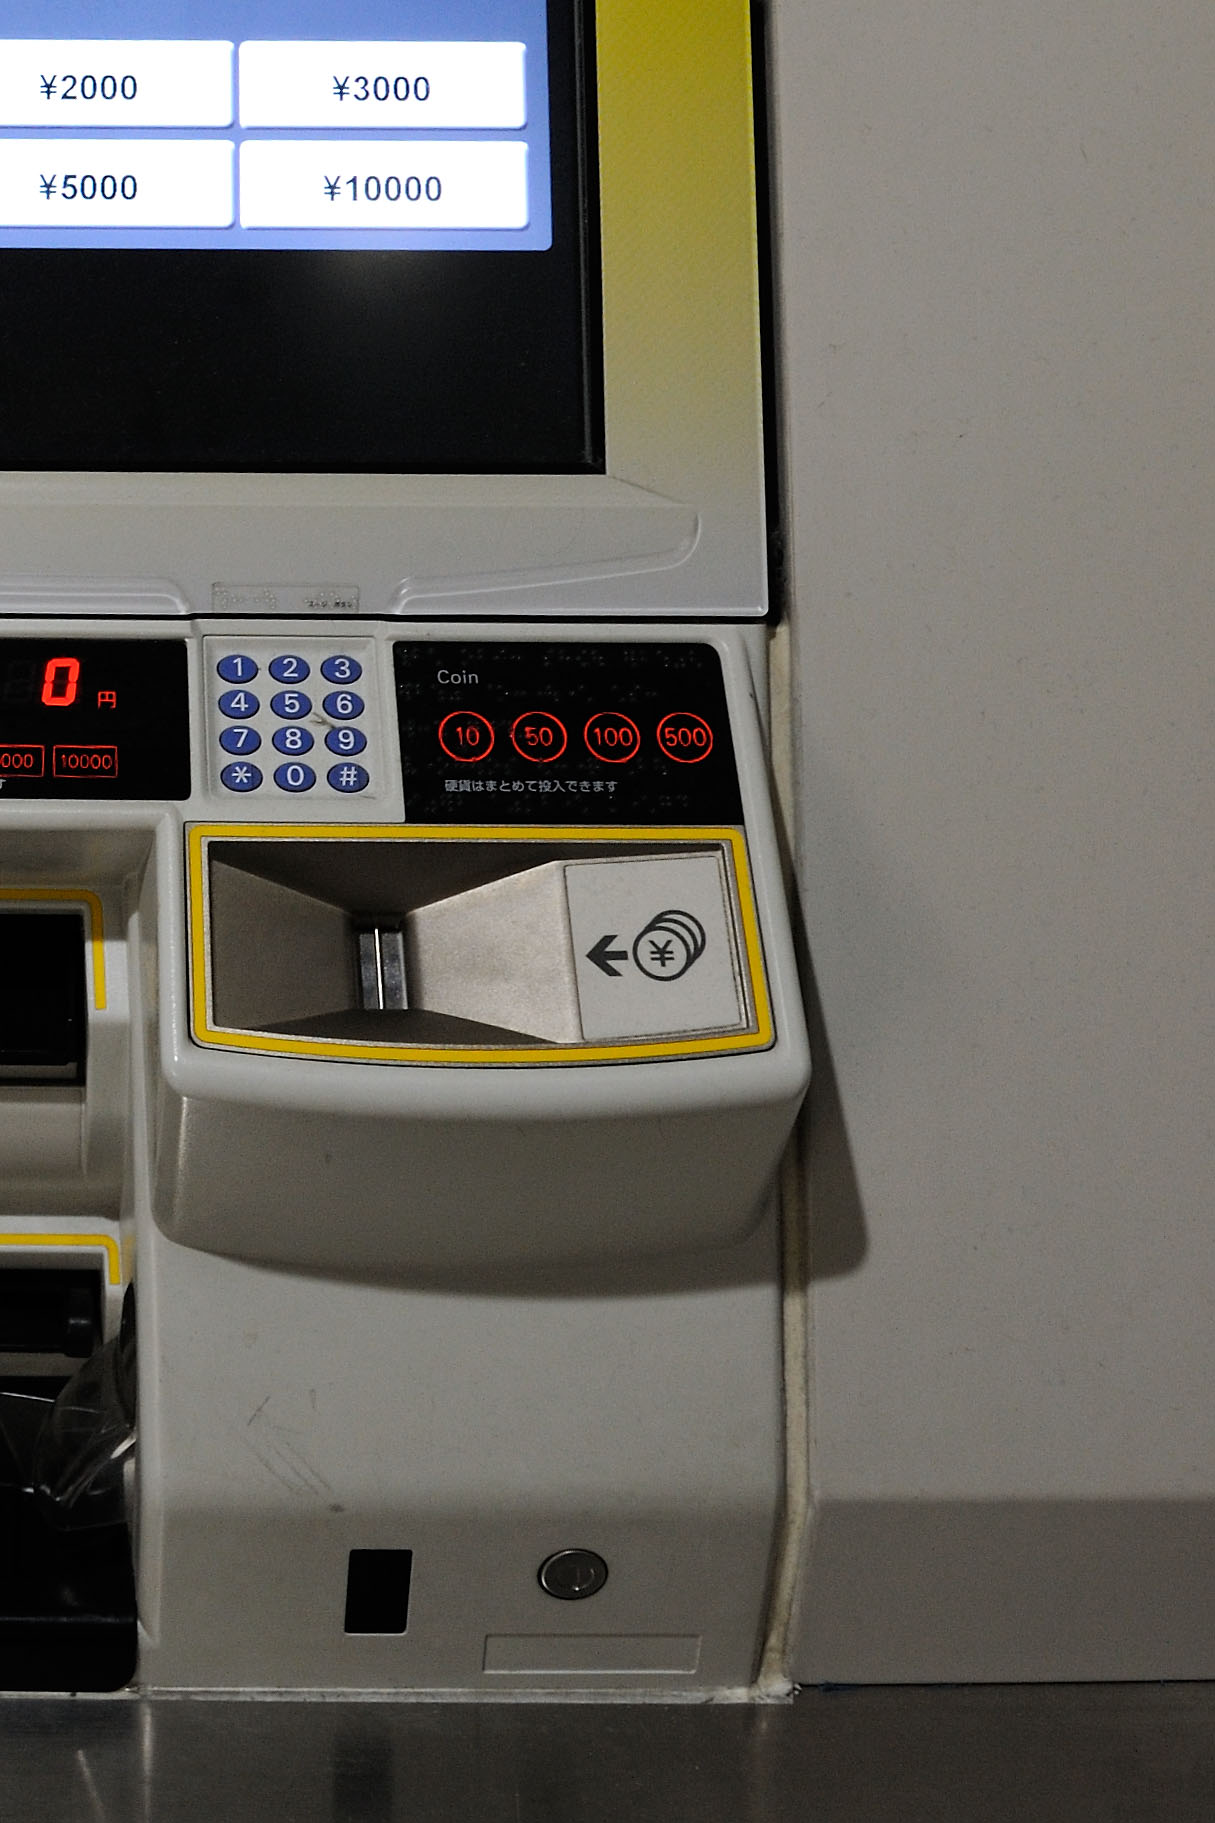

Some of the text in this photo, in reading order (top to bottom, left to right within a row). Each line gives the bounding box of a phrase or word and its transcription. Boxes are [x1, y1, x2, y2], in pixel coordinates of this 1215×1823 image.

[40, 75, 137, 99] ¥2000
[333, 76, 429, 101] ¥3000
[40, 175, 137, 200] ¥5000
[324, 176, 441, 201] ¥10000
[233, 658, 351, 678] 1 2 3
[438, 670, 478, 684] Coin
[41, 657, 116, 708] 0 円
[231, 692, 353, 713] 4 5 6
[233, 729, 355, 749] 7 8 9
[456, 727, 706, 746] 10 50 100 500
[62, 754, 112, 769] 10000
[287, 765, 304, 786] 0
[445, 780, 617, 792] 硬貨はまとめて投入できます
